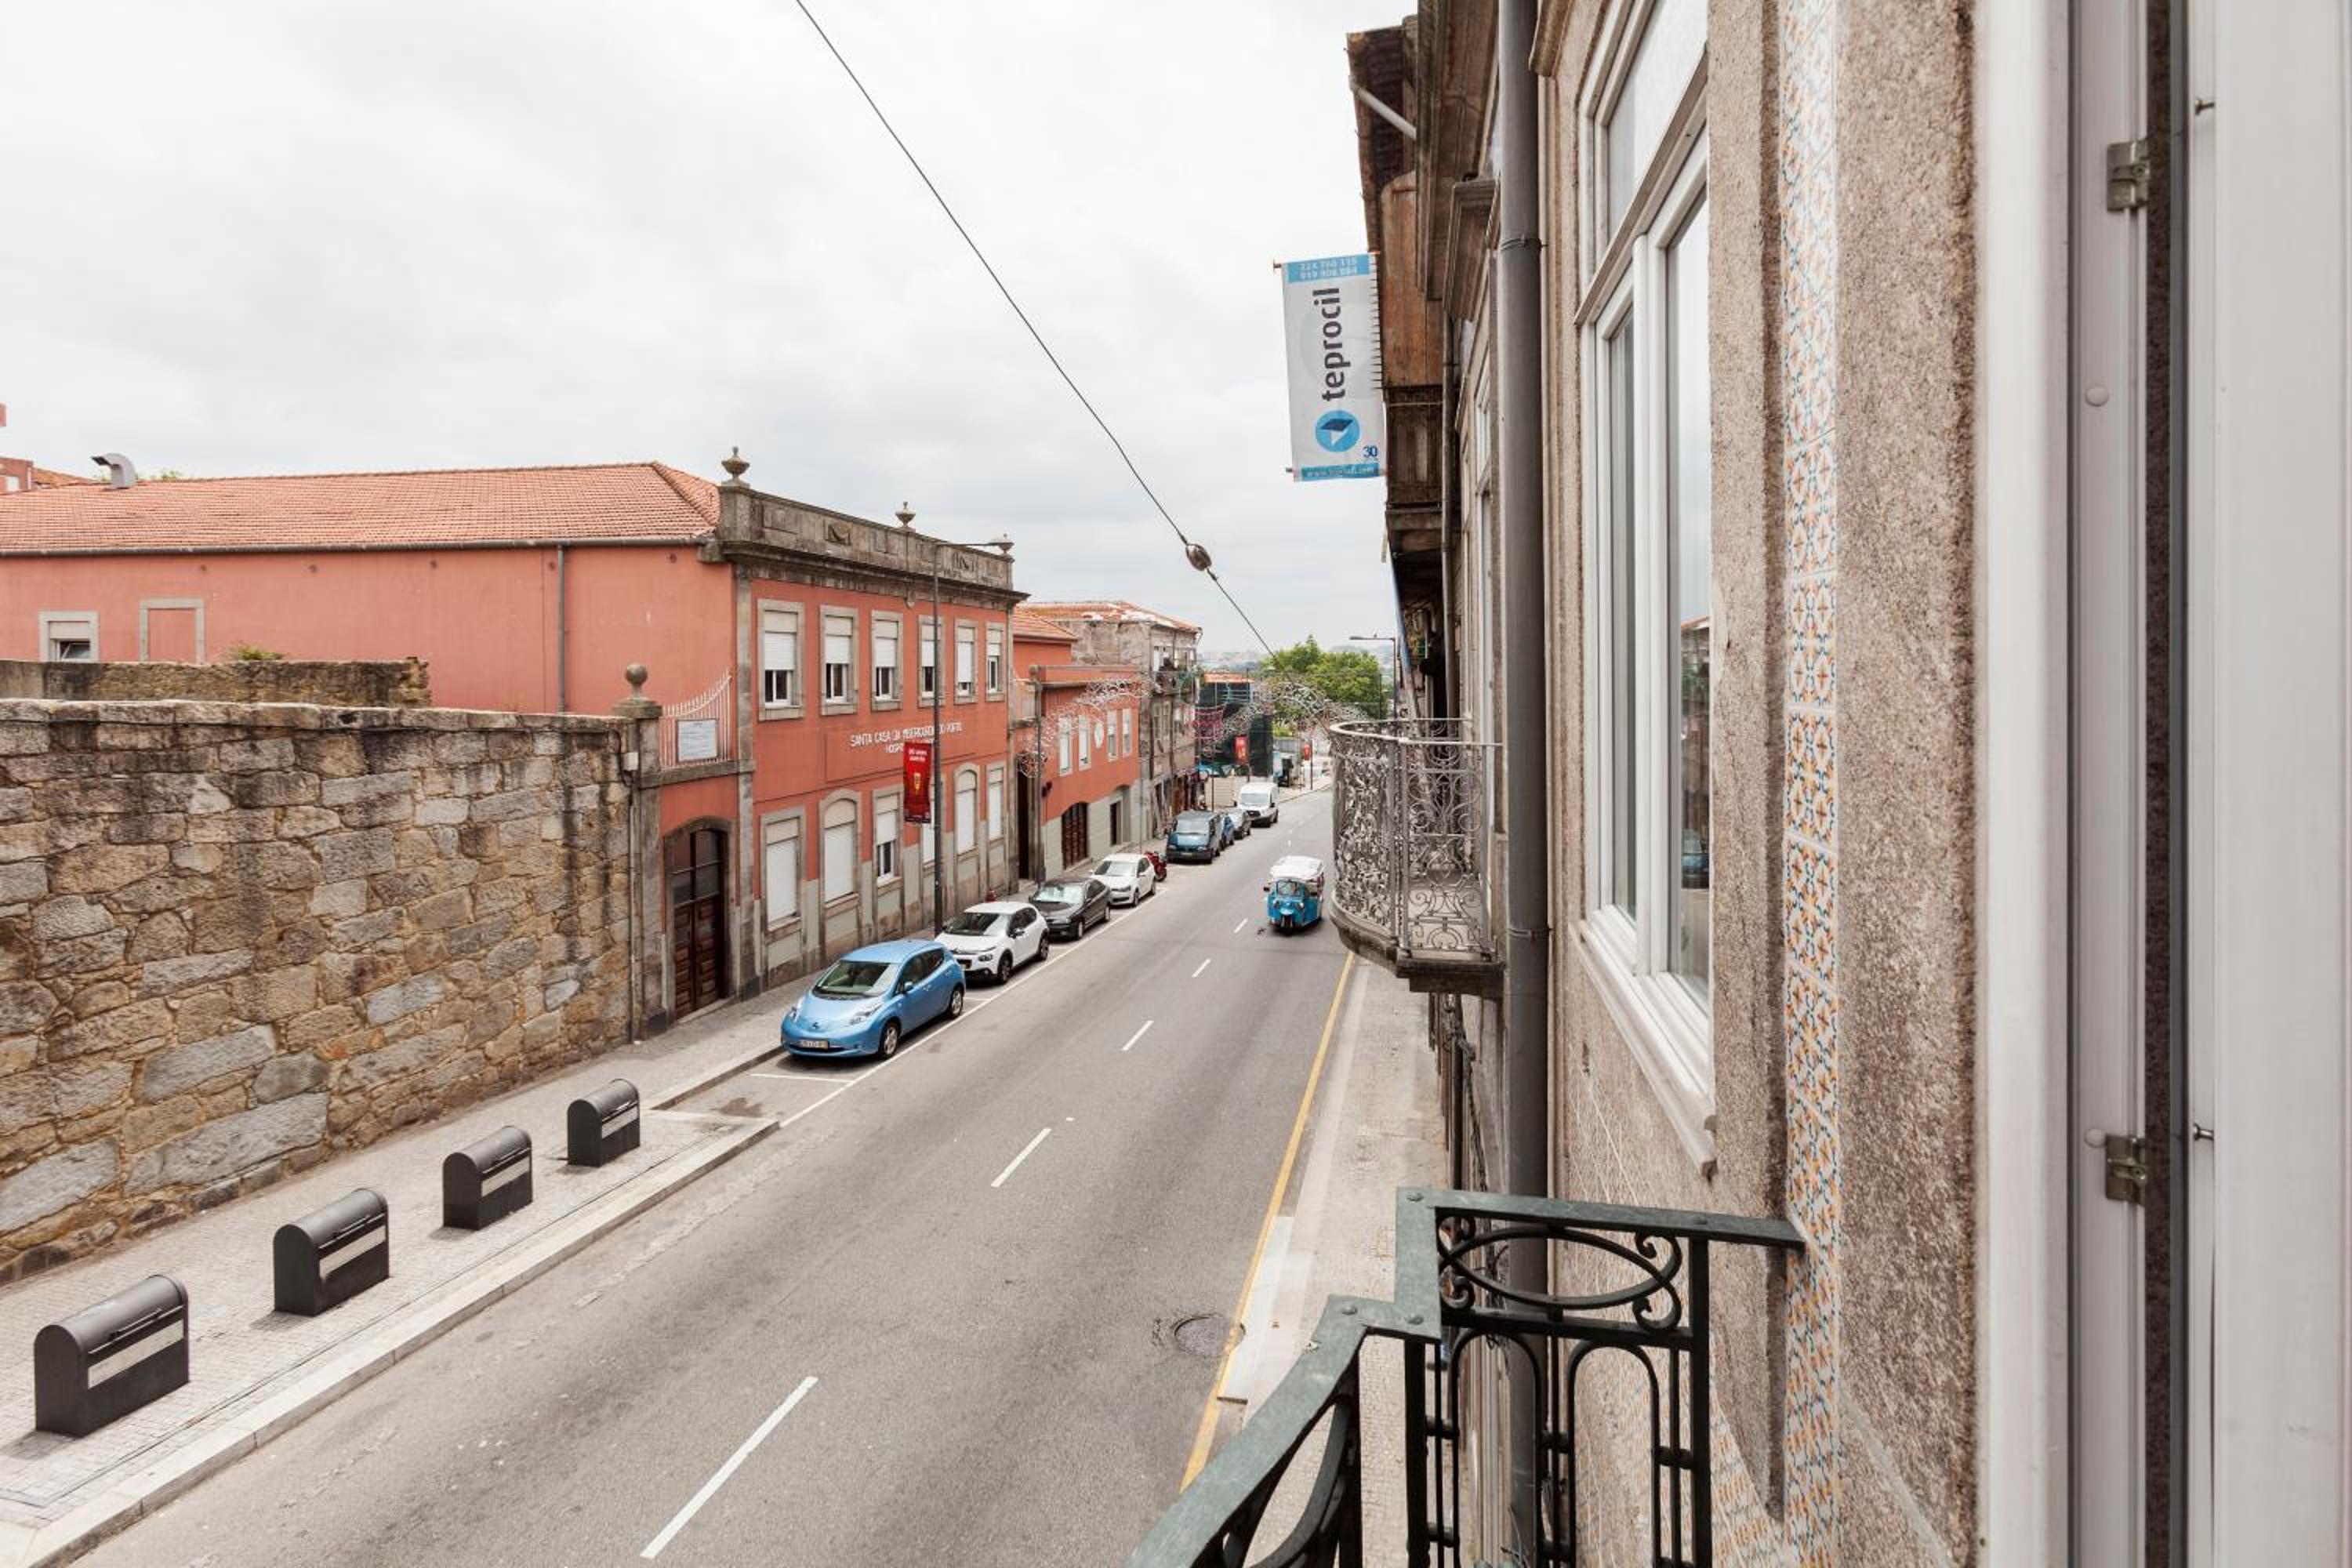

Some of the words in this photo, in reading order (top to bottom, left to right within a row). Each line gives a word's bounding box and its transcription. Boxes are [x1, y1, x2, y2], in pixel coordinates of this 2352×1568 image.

[1312, 288, 1351, 401] teprocil
[1363, 445, 1378, 458] 30
[850, 733, 873, 747] SANTA
[874, 731, 891, 743] CASA
